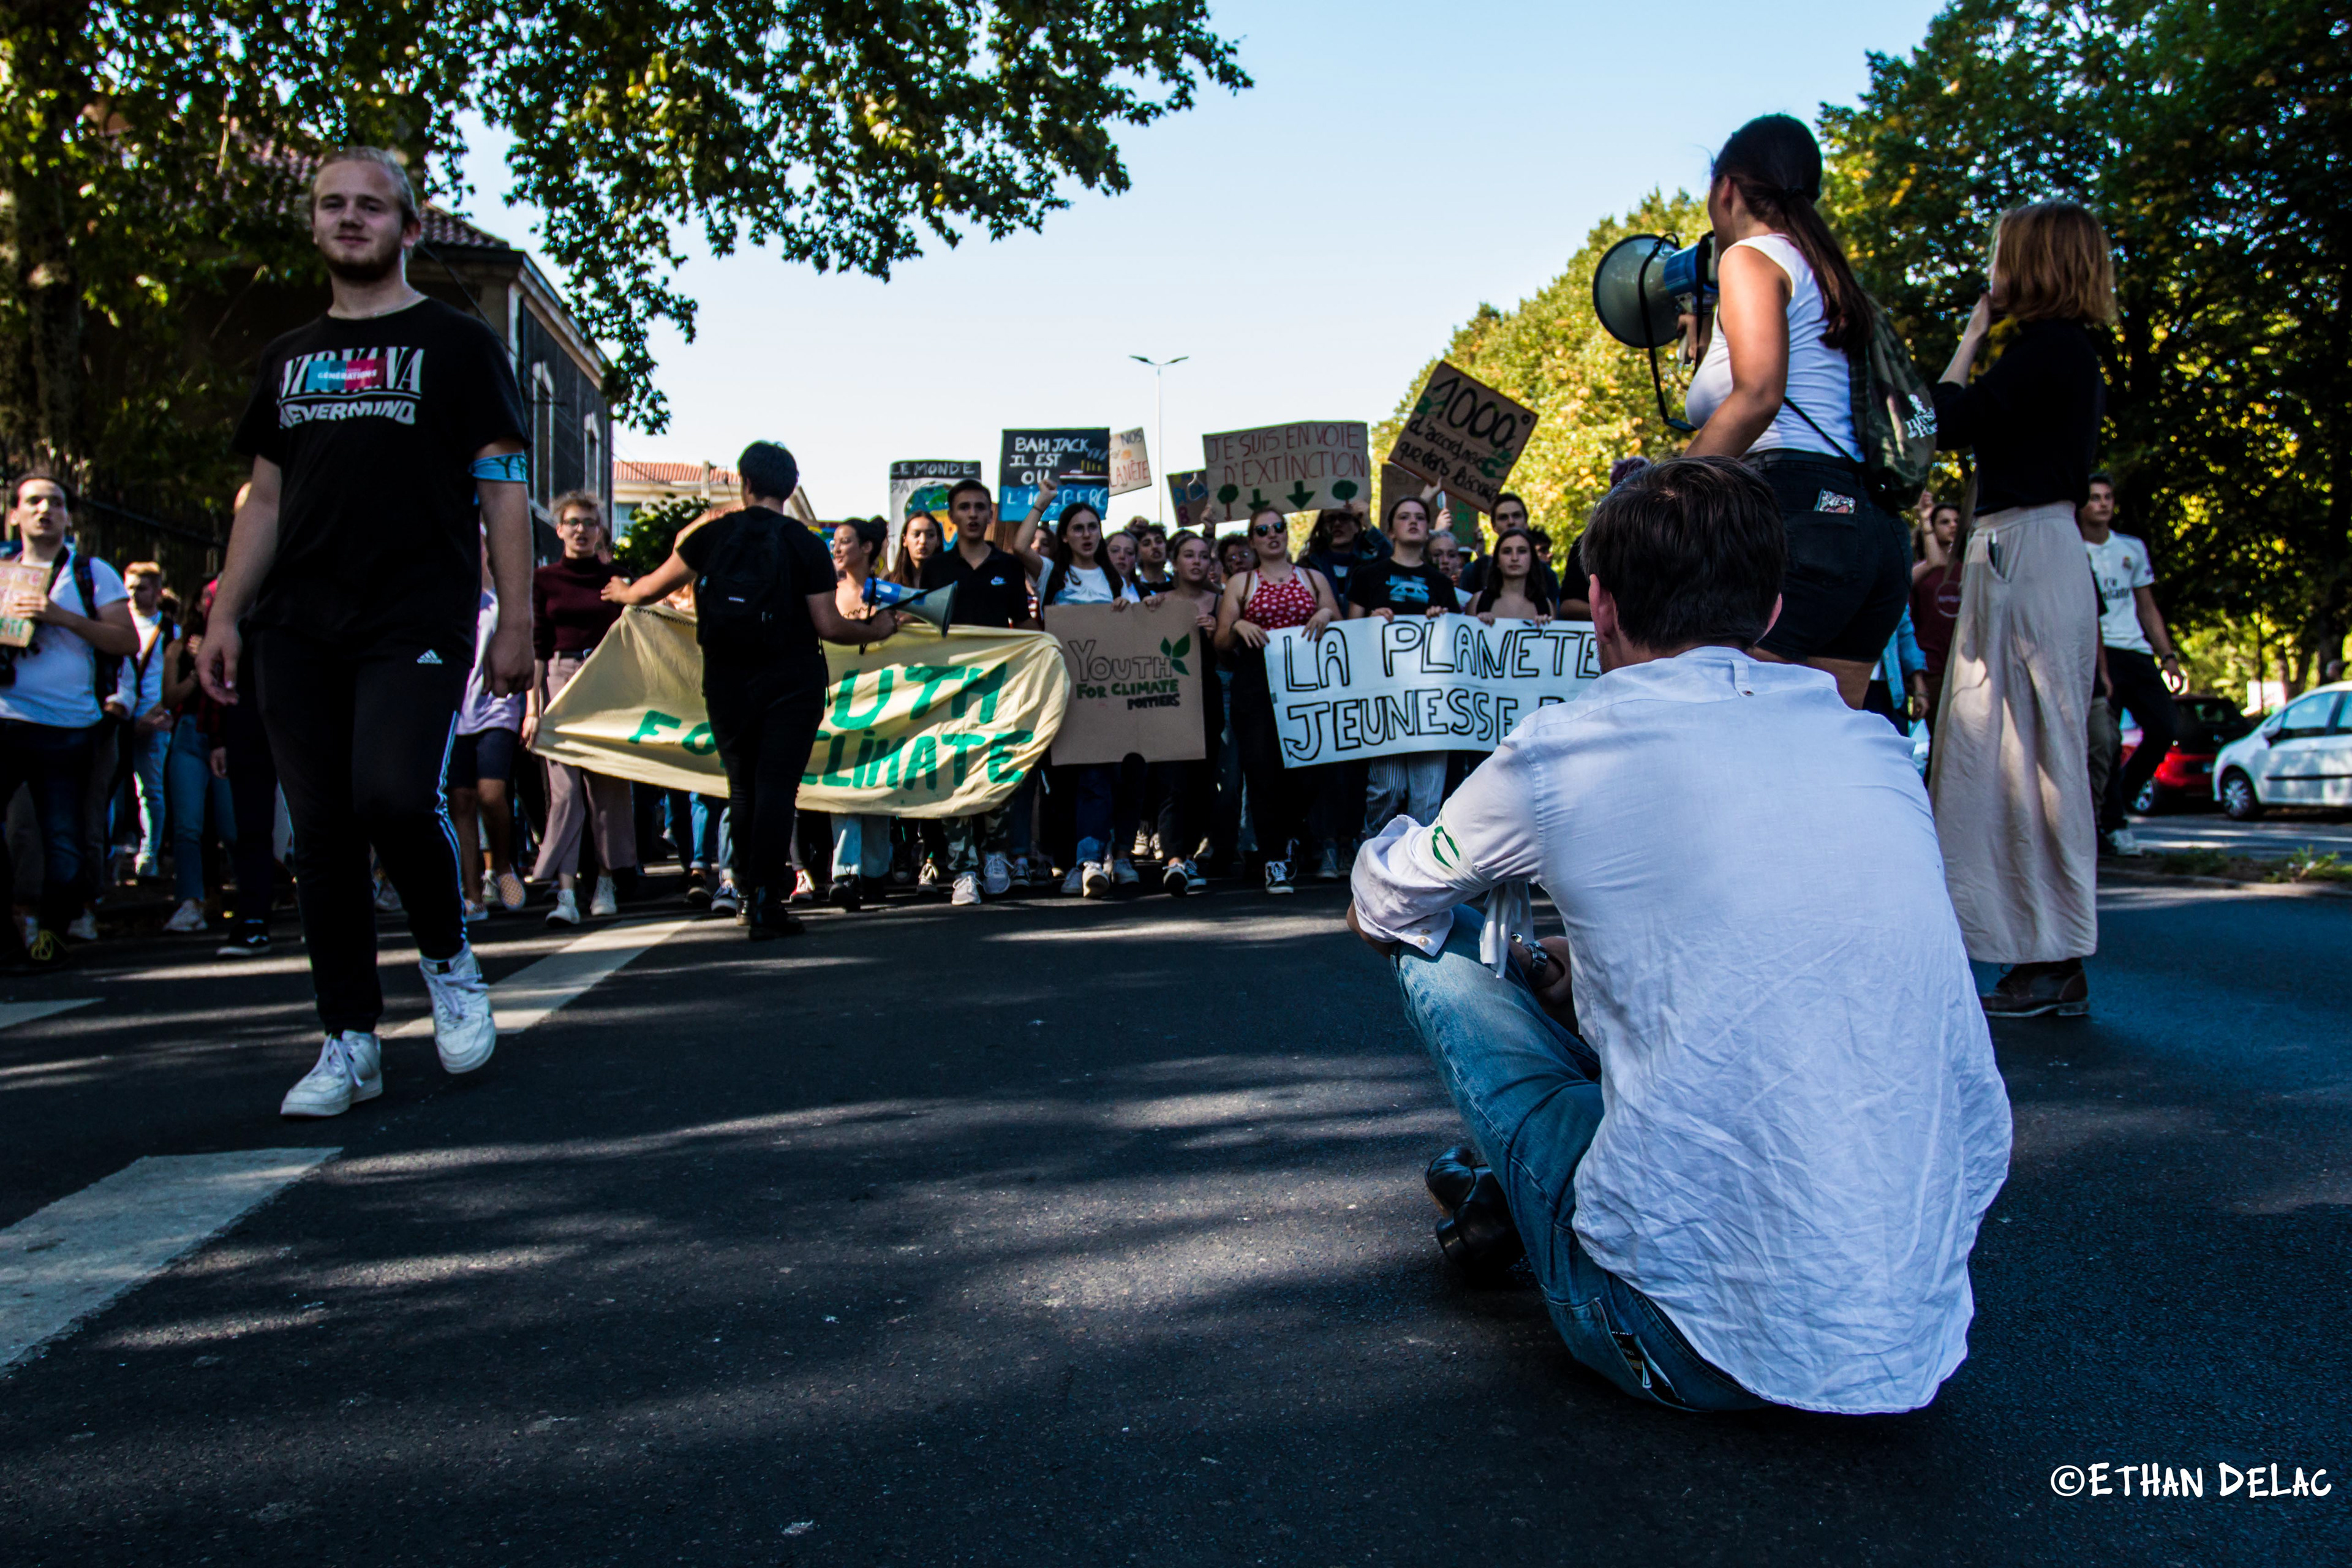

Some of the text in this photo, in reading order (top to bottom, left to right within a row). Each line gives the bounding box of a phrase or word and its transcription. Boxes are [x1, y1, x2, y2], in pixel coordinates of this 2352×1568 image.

[1015, 437, 1089, 453] BAH JACK
[1120, 430, 1143, 446] NOS
[1208, 424, 1360, 462] JE SUIS EN VOIE
[914, 462, 975, 476] MONDE
[1009, 453, 1062, 467] IL EST
[1224, 451, 1365, 487] D'EXTINCTION
[1068, 639, 1172, 682] YOUTH
[1283, 620, 1600, 692] LA PLANÈTE
[1076, 679, 1179, 699] FOR CLIMATE
[1126, 693, 1180, 710] POITIERS
[1284, 688, 1518, 761] JEUNESSE
[628, 710, 723, 768] FO
